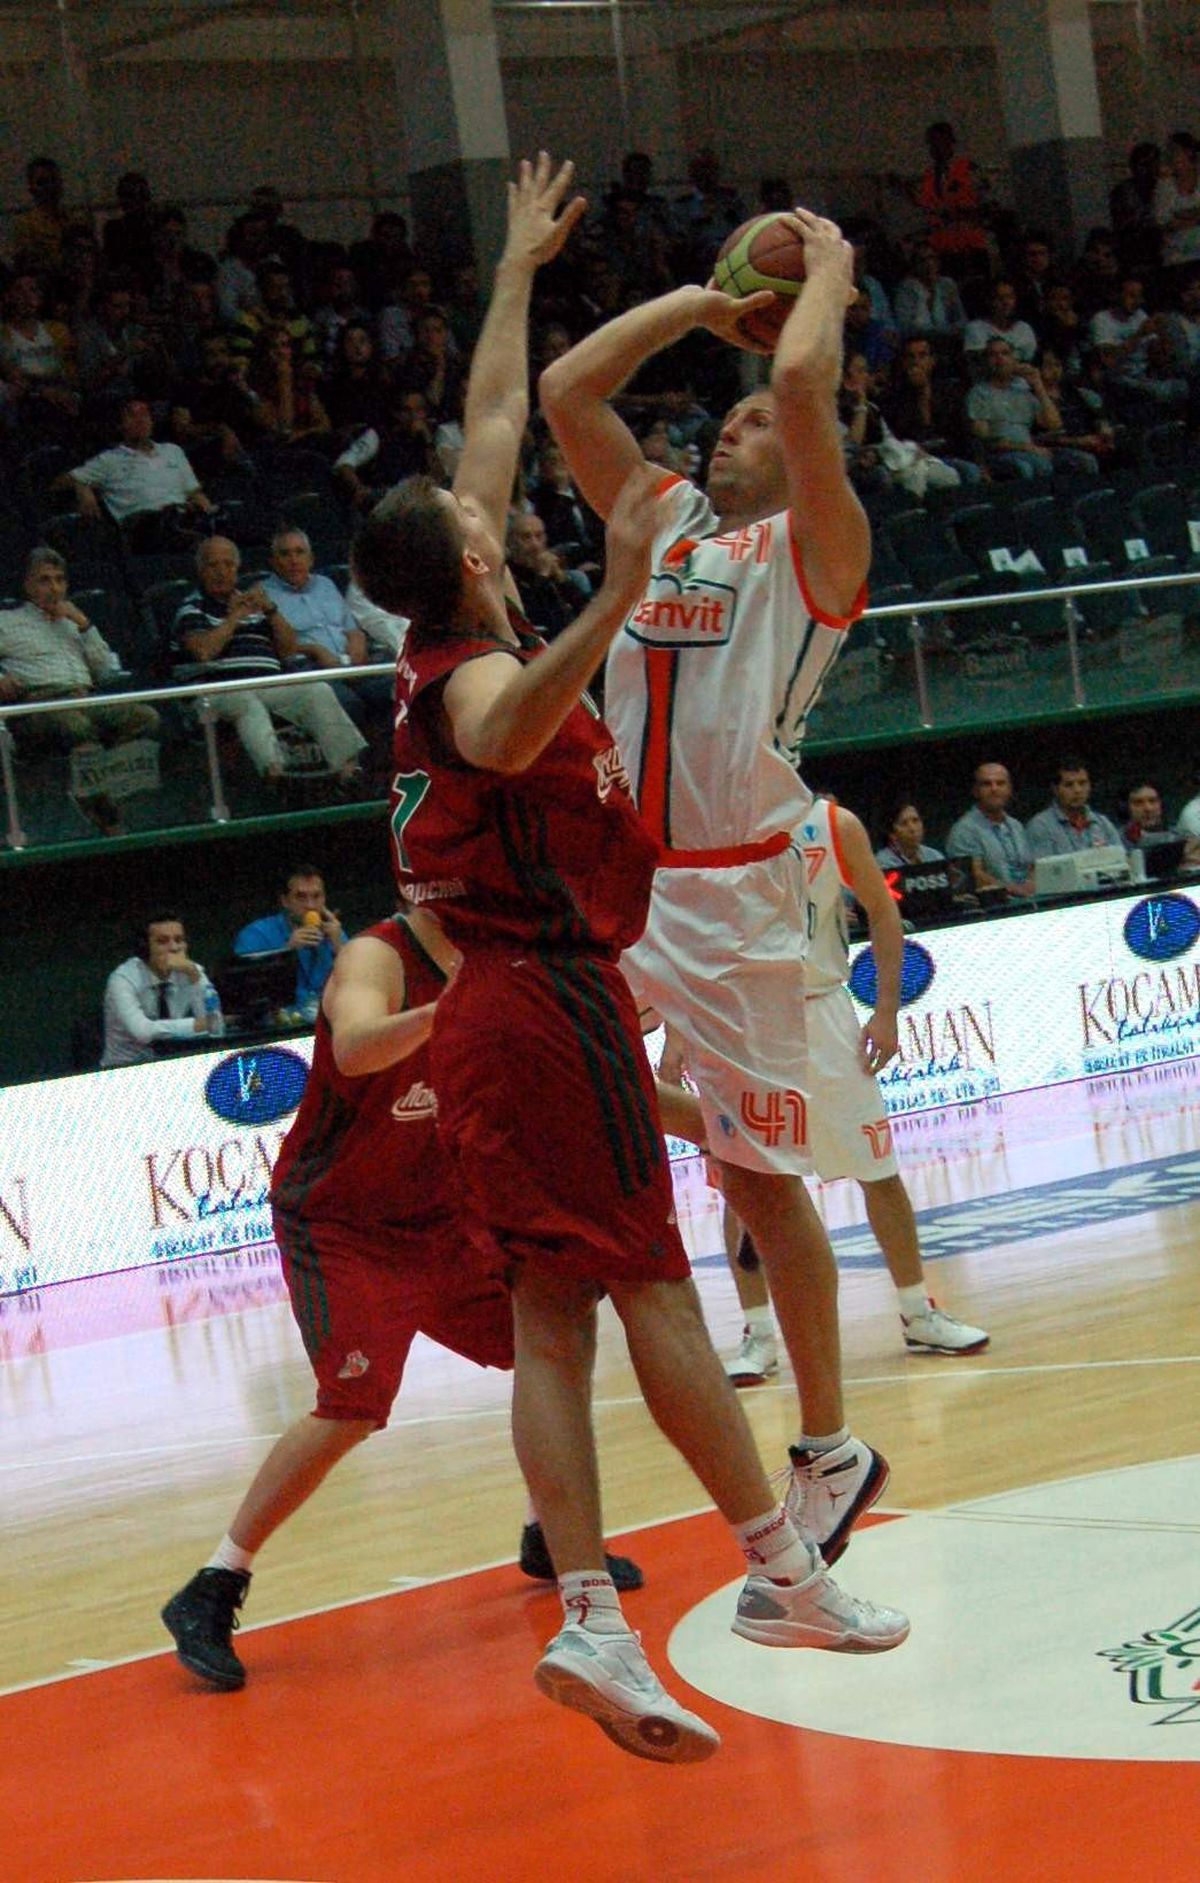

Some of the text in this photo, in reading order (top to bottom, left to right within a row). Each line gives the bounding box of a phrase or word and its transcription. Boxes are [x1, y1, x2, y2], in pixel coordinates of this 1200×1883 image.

[633, 597, 725, 633] anvit
[803, 846, 827, 884] 7
[905, 873, 949, 892] POSS
[900, 1001, 996, 1071] MAN
[740, 1089, 807, 1147] 41
[862, 1118, 892, 1160] 17
